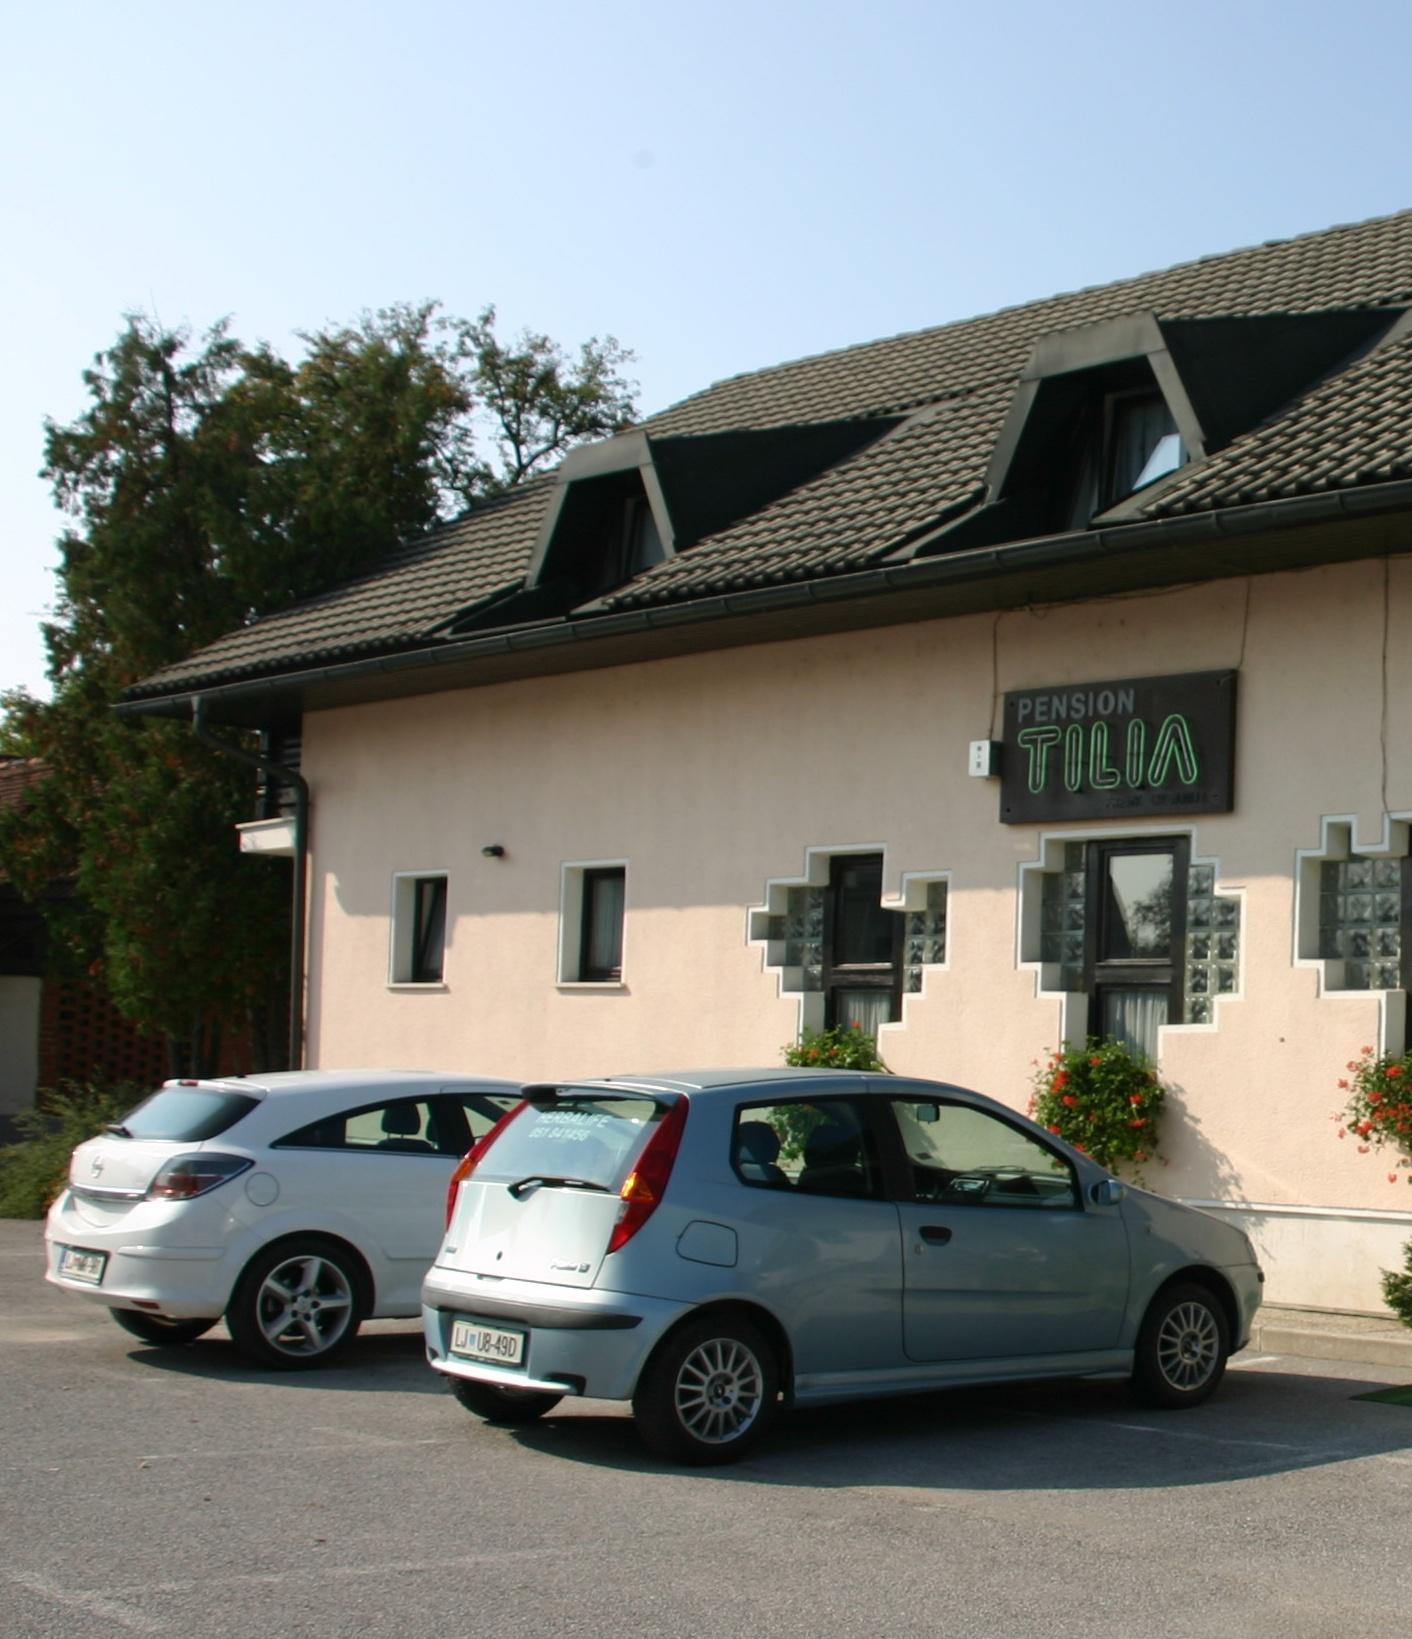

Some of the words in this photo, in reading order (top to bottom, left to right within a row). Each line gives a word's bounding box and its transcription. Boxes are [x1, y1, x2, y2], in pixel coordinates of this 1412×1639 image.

[1017, 687, 1135, 723] PENSION
[1017, 713, 1198, 794] TILIA
[536, 1111, 613, 1128] HERBALIFE
[455, 1327, 469, 1348] LJ
